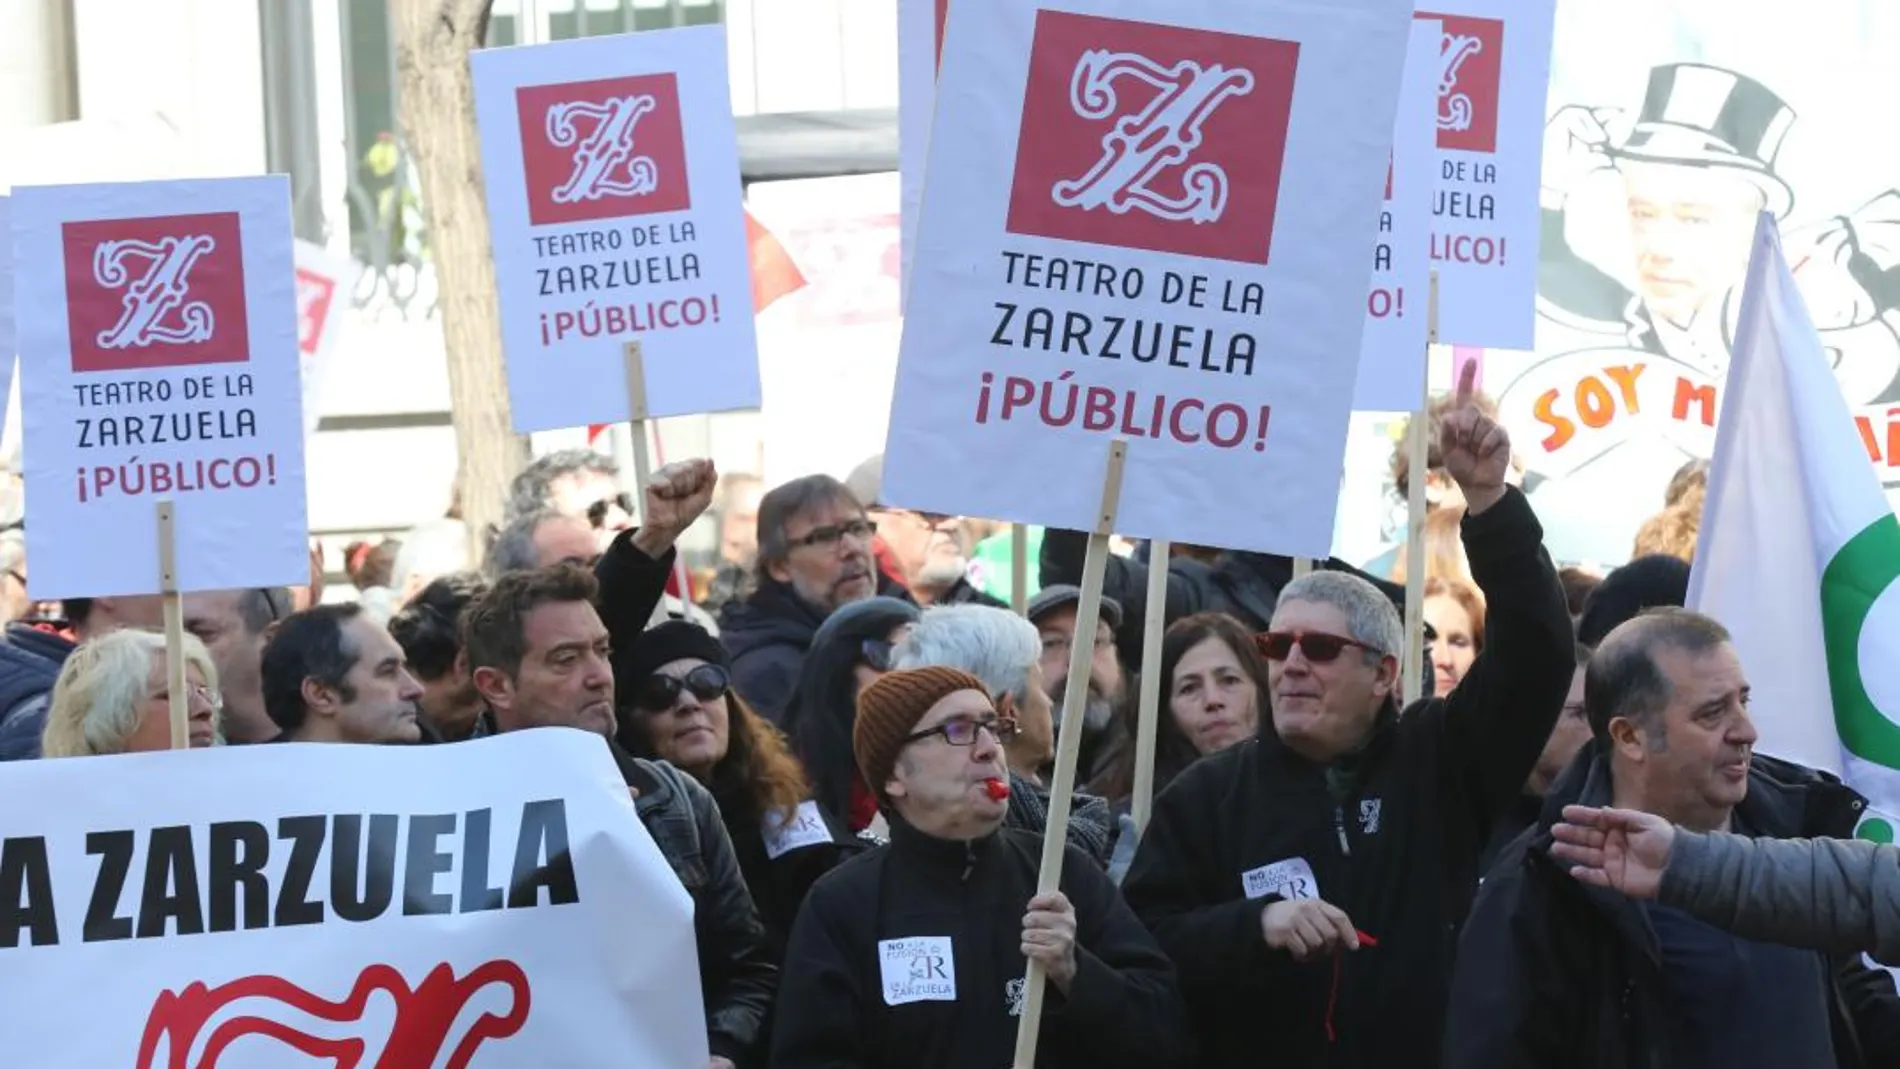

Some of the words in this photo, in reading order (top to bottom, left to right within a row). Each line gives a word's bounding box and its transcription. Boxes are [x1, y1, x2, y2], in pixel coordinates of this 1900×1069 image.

[1442, 160, 1465, 181] DE
[1473, 162, 1496, 184] LA
[533, 229, 622, 257] TEATRO
[633, 226, 660, 248] DE
[670, 221, 696, 243] LA
[536, 253, 700, 296] ZARZUELA
[1002, 251, 1144, 299] TEATRO
[1161, 271, 1208, 308] DE
[1223, 280, 1264, 315] LA
[540, 294, 720, 346] ¡PÚBLICO!
[990, 301, 1257, 376] ZARZUELA
[74, 380, 171, 407] TEATRO
[184, 376, 213, 399] DE
[226, 374, 252, 396] LA
[975, 370, 1271, 452] ¡PÚBLICO!
[1533, 363, 1646, 453] SOY
[76, 408, 256, 447] ZARZUELA
[78, 454, 275, 502] ¡PÚBLICO!
[83, 798, 579, 942] ZARZUELA
[1249, 870, 1265, 881] NO
[887, 942, 904, 950] NO
